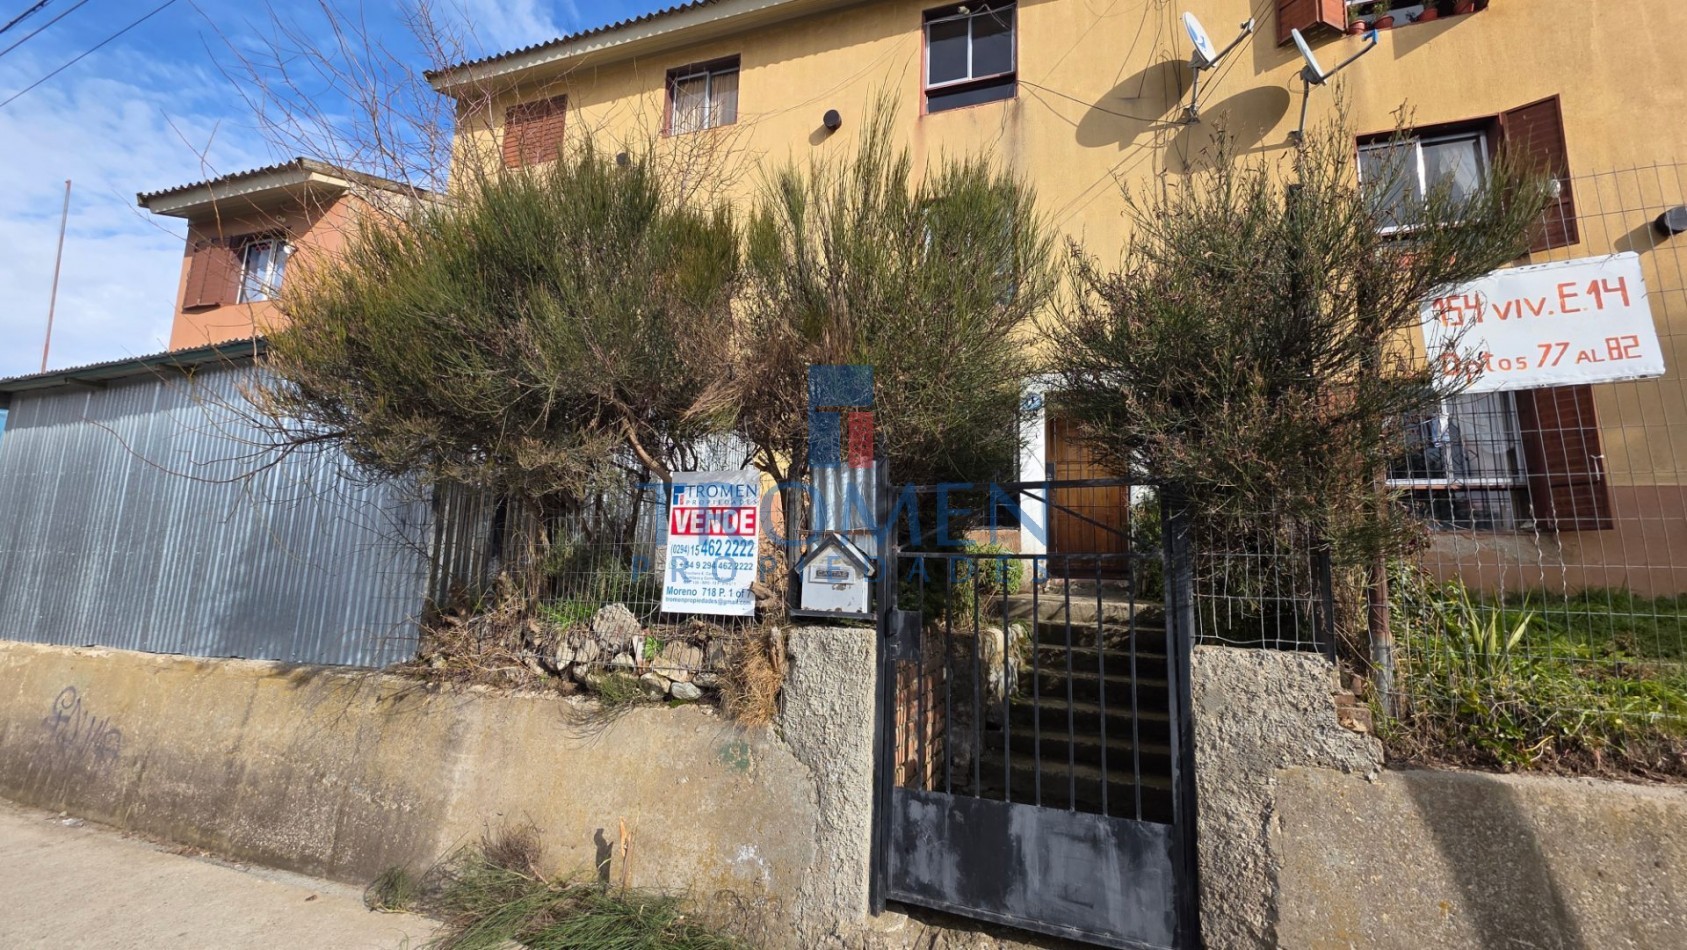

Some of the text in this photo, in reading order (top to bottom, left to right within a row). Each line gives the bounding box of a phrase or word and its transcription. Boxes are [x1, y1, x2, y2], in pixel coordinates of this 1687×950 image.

[1432, 290, 1484, 327] 154
[1537, 342, 1570, 368] 77
[1575, 349, 1605, 364] AL
[1605, 335, 1643, 361] 82
[686, 483, 758, 498] TROMEN
[674, 508, 755, 534] VENDE
[671, 539, 754, 557] (0294) 15 462 2222
[702, 562, 716, 570] 294
[666, 586, 697, 596] Moreno
[702, 587, 717, 596] 718
[719, 588, 726, 597] P.
[729, 589, 733, 597] 1
[736, 589, 744, 598] of
[665, 597, 752, 605] tromenpropiedades@gmail.com
